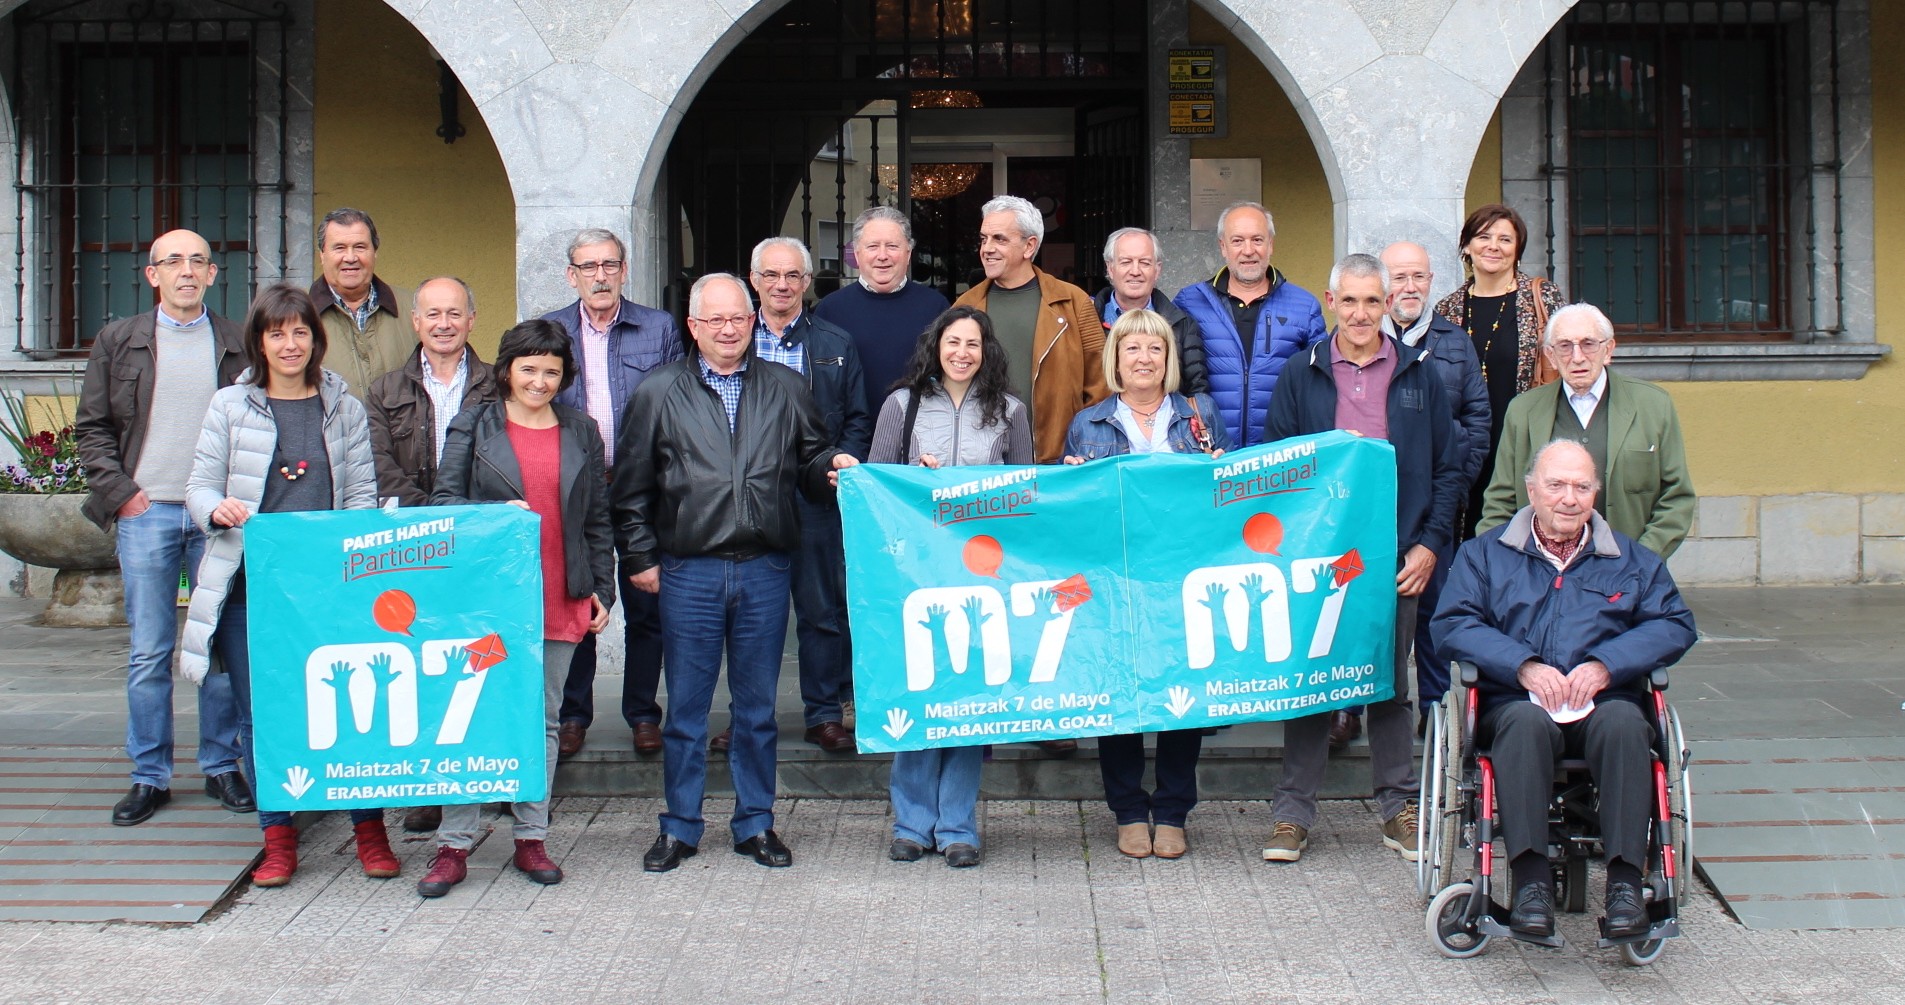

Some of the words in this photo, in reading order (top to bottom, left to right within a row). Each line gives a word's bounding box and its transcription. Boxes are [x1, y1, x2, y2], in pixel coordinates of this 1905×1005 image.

[1213, 458, 1260, 480] PARTE
[1263, 441, 1316, 470] HARTU!
[932, 480, 979, 502] PARTE
[982, 468, 1037, 491] HARTU!
[1213, 457, 1317, 508] ¡Participa!
[932, 482, 1038, 528] ¡Participa!
[343, 529, 394, 552] PARTE
[397, 517, 455, 541] HARTU!
[343, 534, 455, 582] ¡Participa!
[1205, 674, 1289, 696] Maiatzak
[1294, 672, 1304, 687] 7
[1308, 669, 1328, 685] de
[1331, 663, 1374, 683] Mayo
[925, 698, 1009, 719] Maiatzak
[1014, 697, 1025, 712] 7
[1030, 694, 1054, 711] de
[1059, 692, 1111, 713] Mayo
[1207, 692, 1327, 717] ERABAKITZERA
[1330, 683, 1375, 701] GOAZ!
[926, 718, 1055, 740] ERABAKITZERA
[1059, 713, 1113, 730] GOAZ!
[326, 760, 414, 778] Maiatzak
[419, 759, 431, 774] 7
[437, 757, 462, 773] de
[467, 756, 519, 775] Mayo
[327, 780, 462, 800] ERABAKITZERA
[466, 780, 520, 794] GOAZ!
